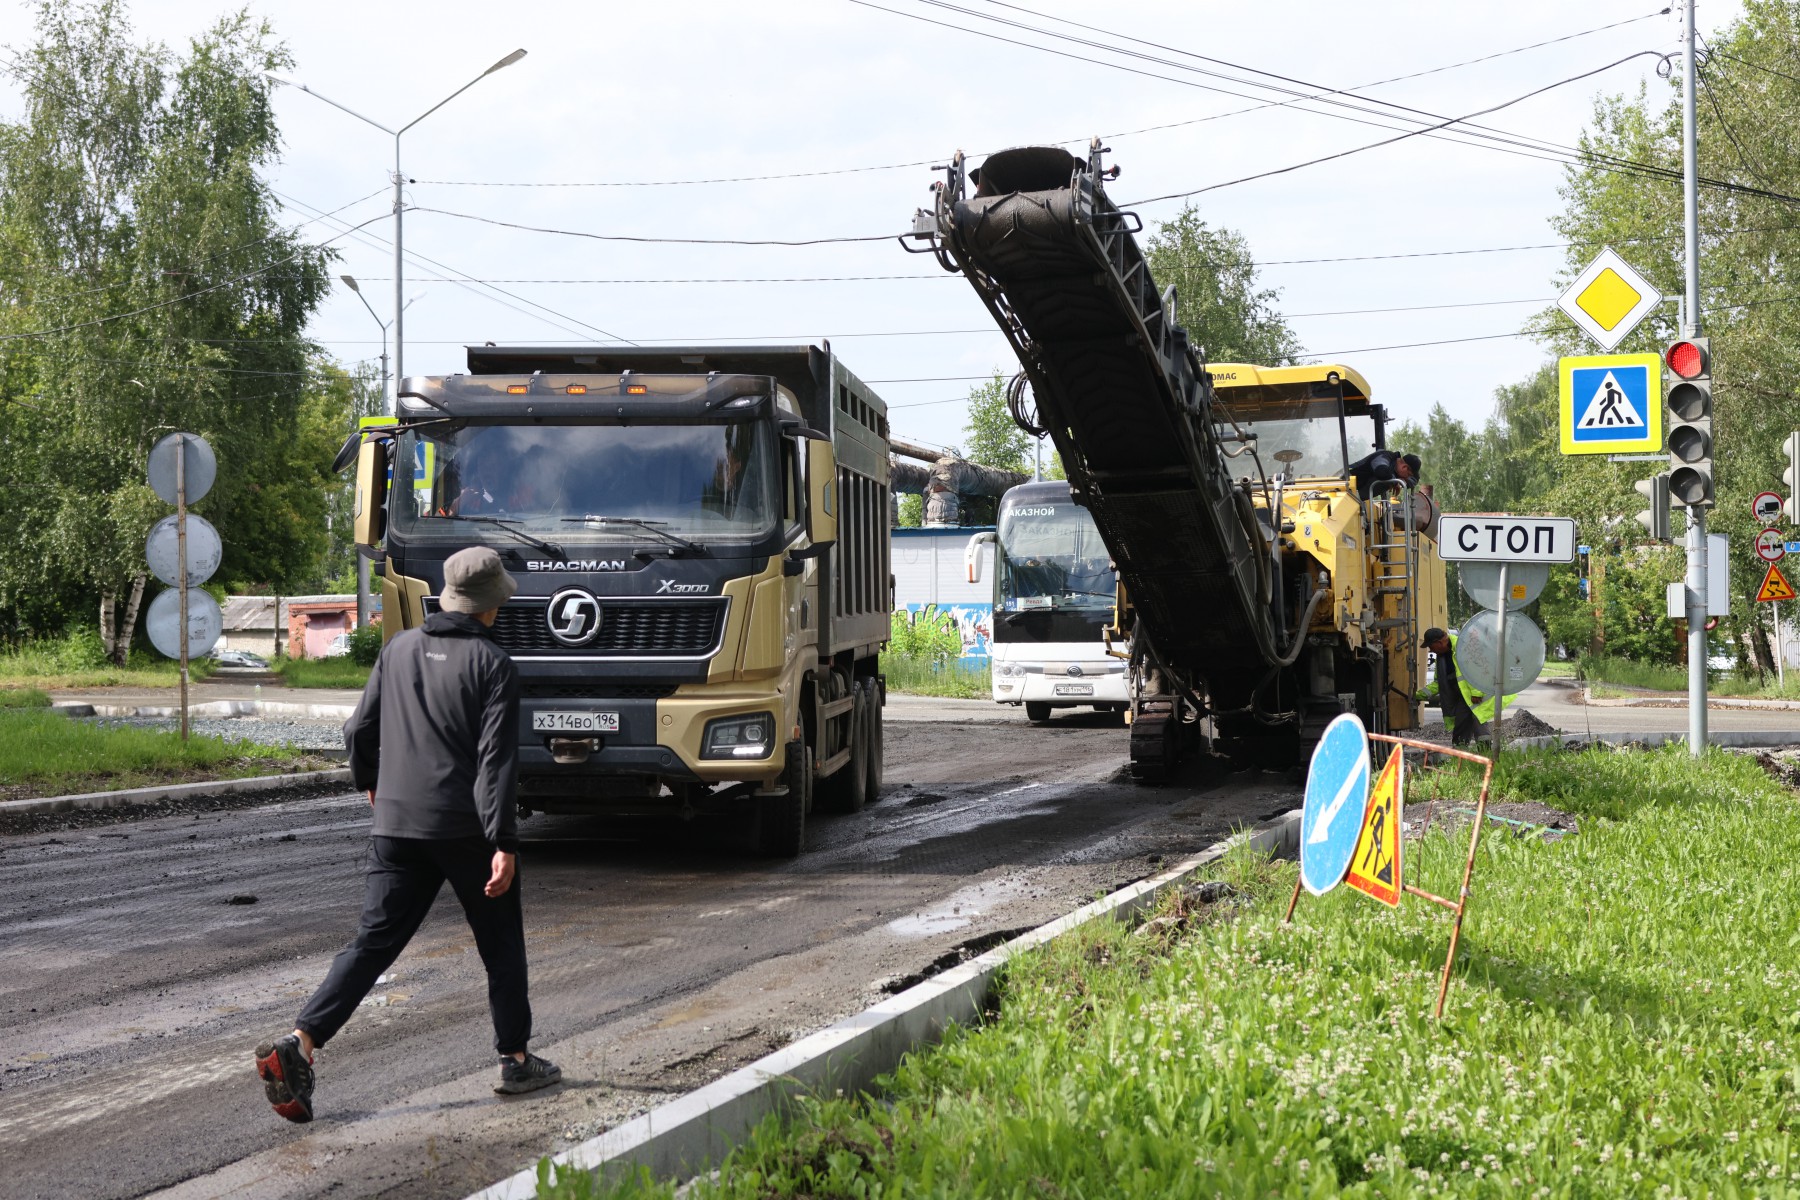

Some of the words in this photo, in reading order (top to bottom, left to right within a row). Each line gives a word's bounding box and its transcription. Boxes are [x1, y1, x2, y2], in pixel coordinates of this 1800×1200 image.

[1211, 373, 1237, 381] OMAG
[1457, 524, 1554, 554] СТОП
[526, 560, 625, 571] SHACMAN
[656, 579, 709, 594] X3000
